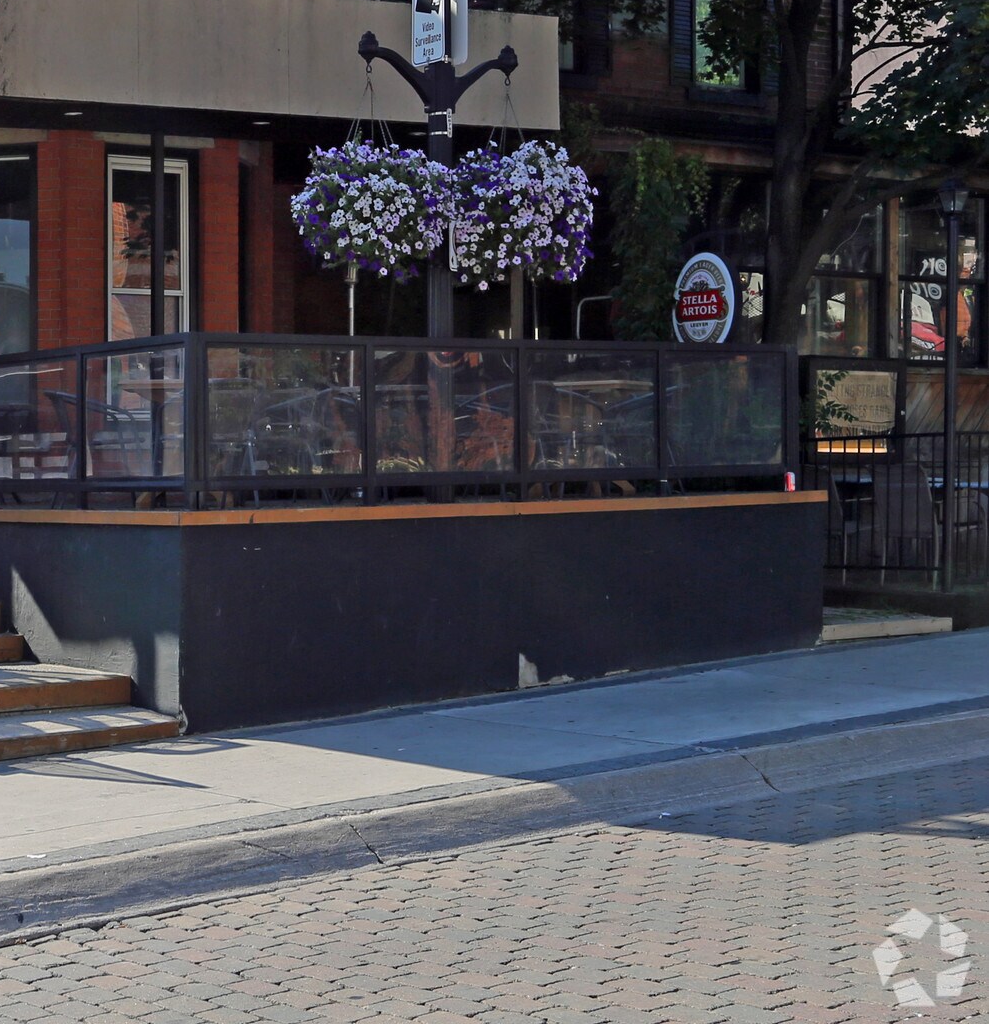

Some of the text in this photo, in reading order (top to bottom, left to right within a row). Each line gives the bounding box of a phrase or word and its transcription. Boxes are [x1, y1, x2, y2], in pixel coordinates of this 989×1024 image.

[422, 22, 435, 32] Video
[415, 33, 442, 47] Surveillance
[422, 47, 434, 57] Area
[682, 294, 718, 306] STELLA
[682, 305, 718, 317] ARTOIS
